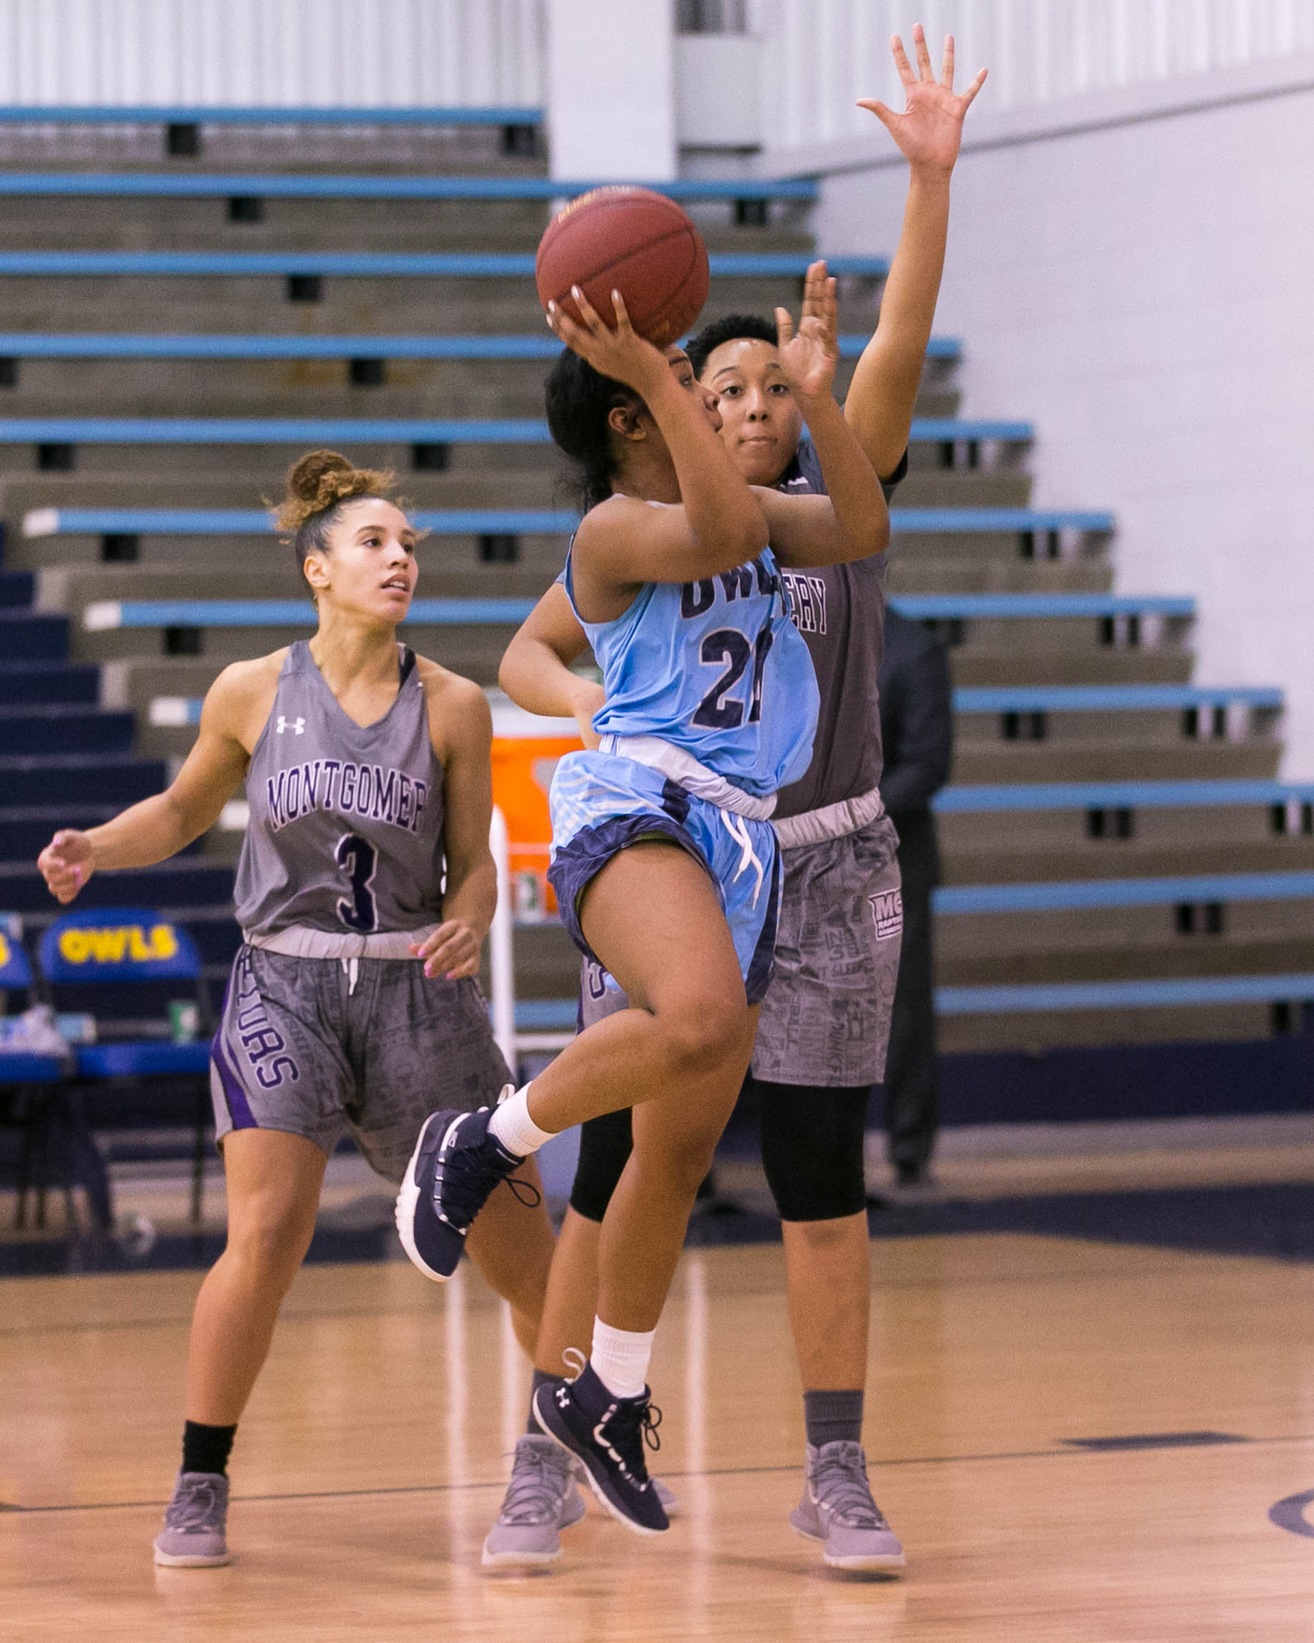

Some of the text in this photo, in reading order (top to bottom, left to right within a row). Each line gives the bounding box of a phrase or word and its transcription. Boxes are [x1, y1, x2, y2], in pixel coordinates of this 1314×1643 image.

[681, 555, 789, 620] OWL
[333, 832, 380, 933] 3
[59, 923, 179, 965] OWLS
